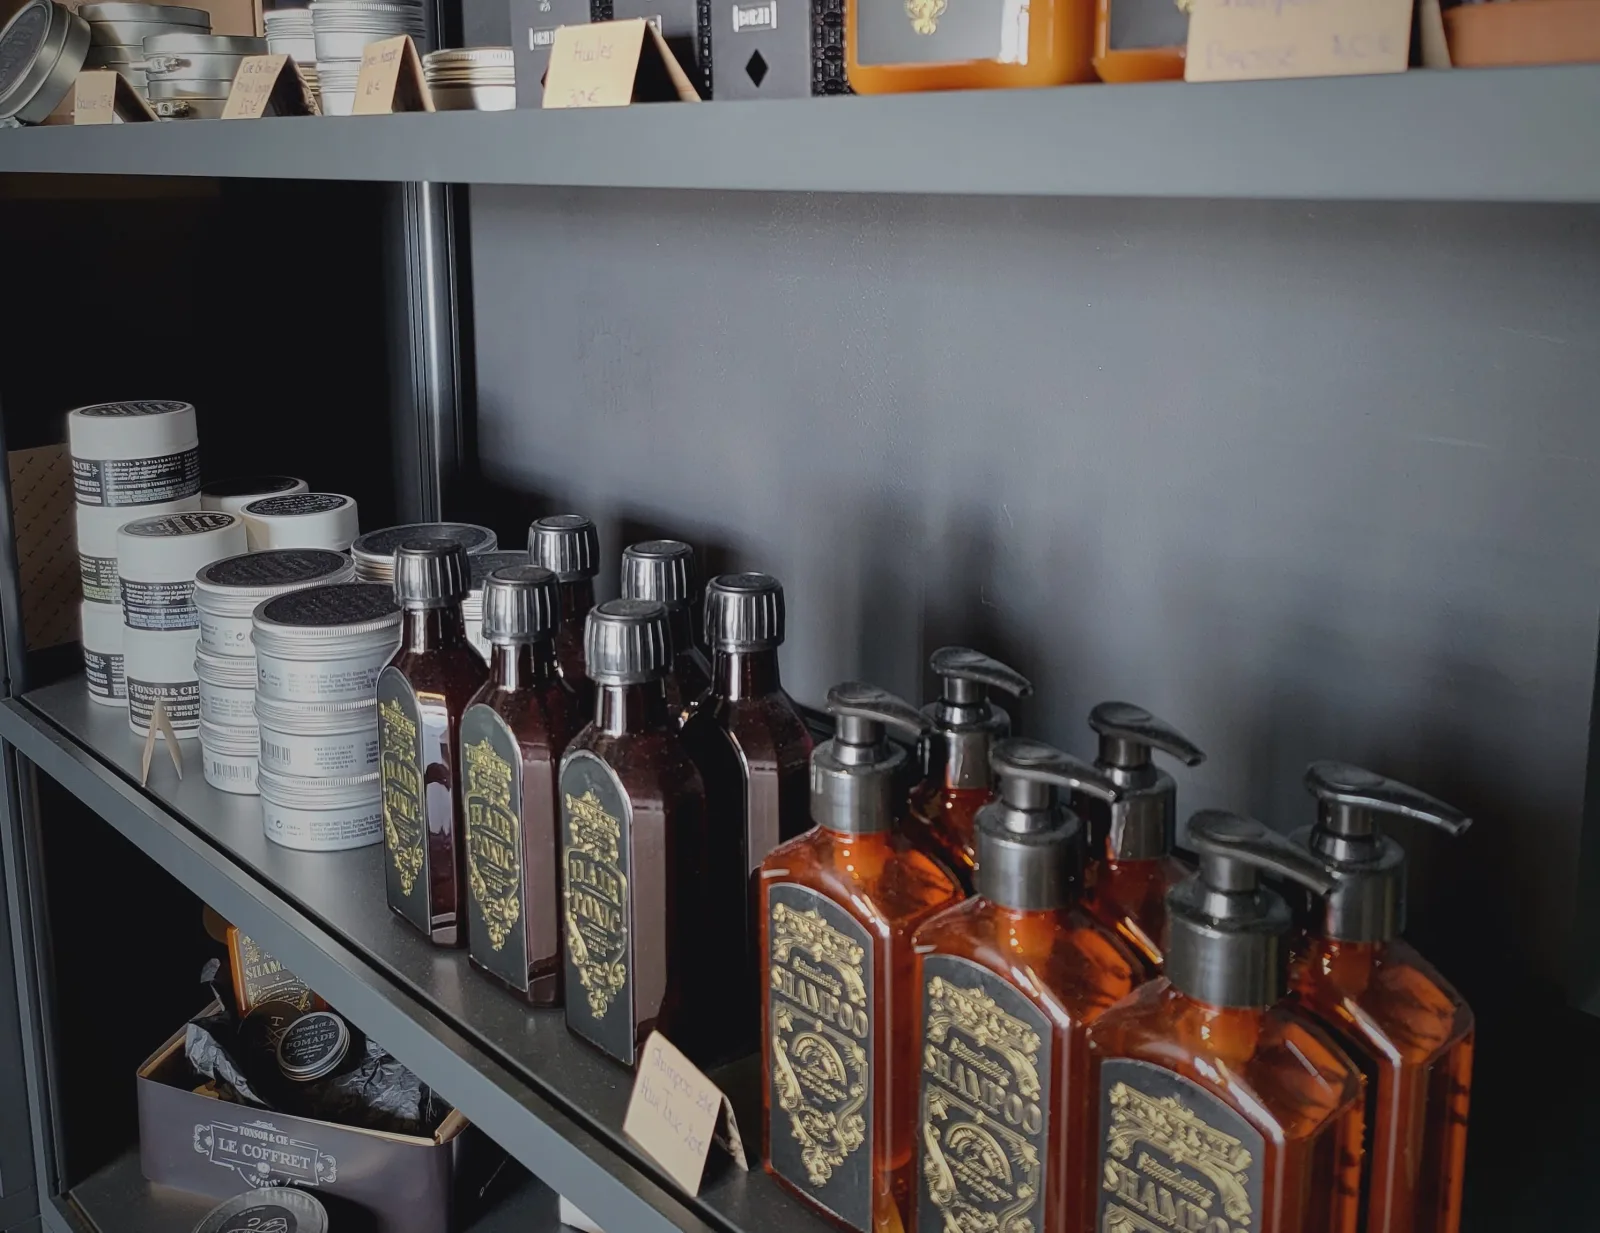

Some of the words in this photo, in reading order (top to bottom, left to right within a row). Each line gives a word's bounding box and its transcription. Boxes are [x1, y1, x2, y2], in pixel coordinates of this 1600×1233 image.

[134, 683, 168, 696] TONSOR
[169, 687, 179, 696] &
[180, 685, 199, 695] CIE
[469, 803, 512, 844] HAIR
[471, 832, 514, 871] TONIC
[569, 858, 621, 907] HAIR
[569, 889, 621, 934] TONIC
[770, 963, 869, 1039] SHAMPOO
[286, 1032, 336, 1049] POMADE
[922, 1043, 1043, 1136] SHAMPOO
[217, 1137, 238, 1154] LE
[241, 1143, 311, 1170] COFFRET
[238, 1125, 268, 1142] TONSOR
[268, 1133, 276, 1143] &
[276, 1134, 289, 1146] CIE
